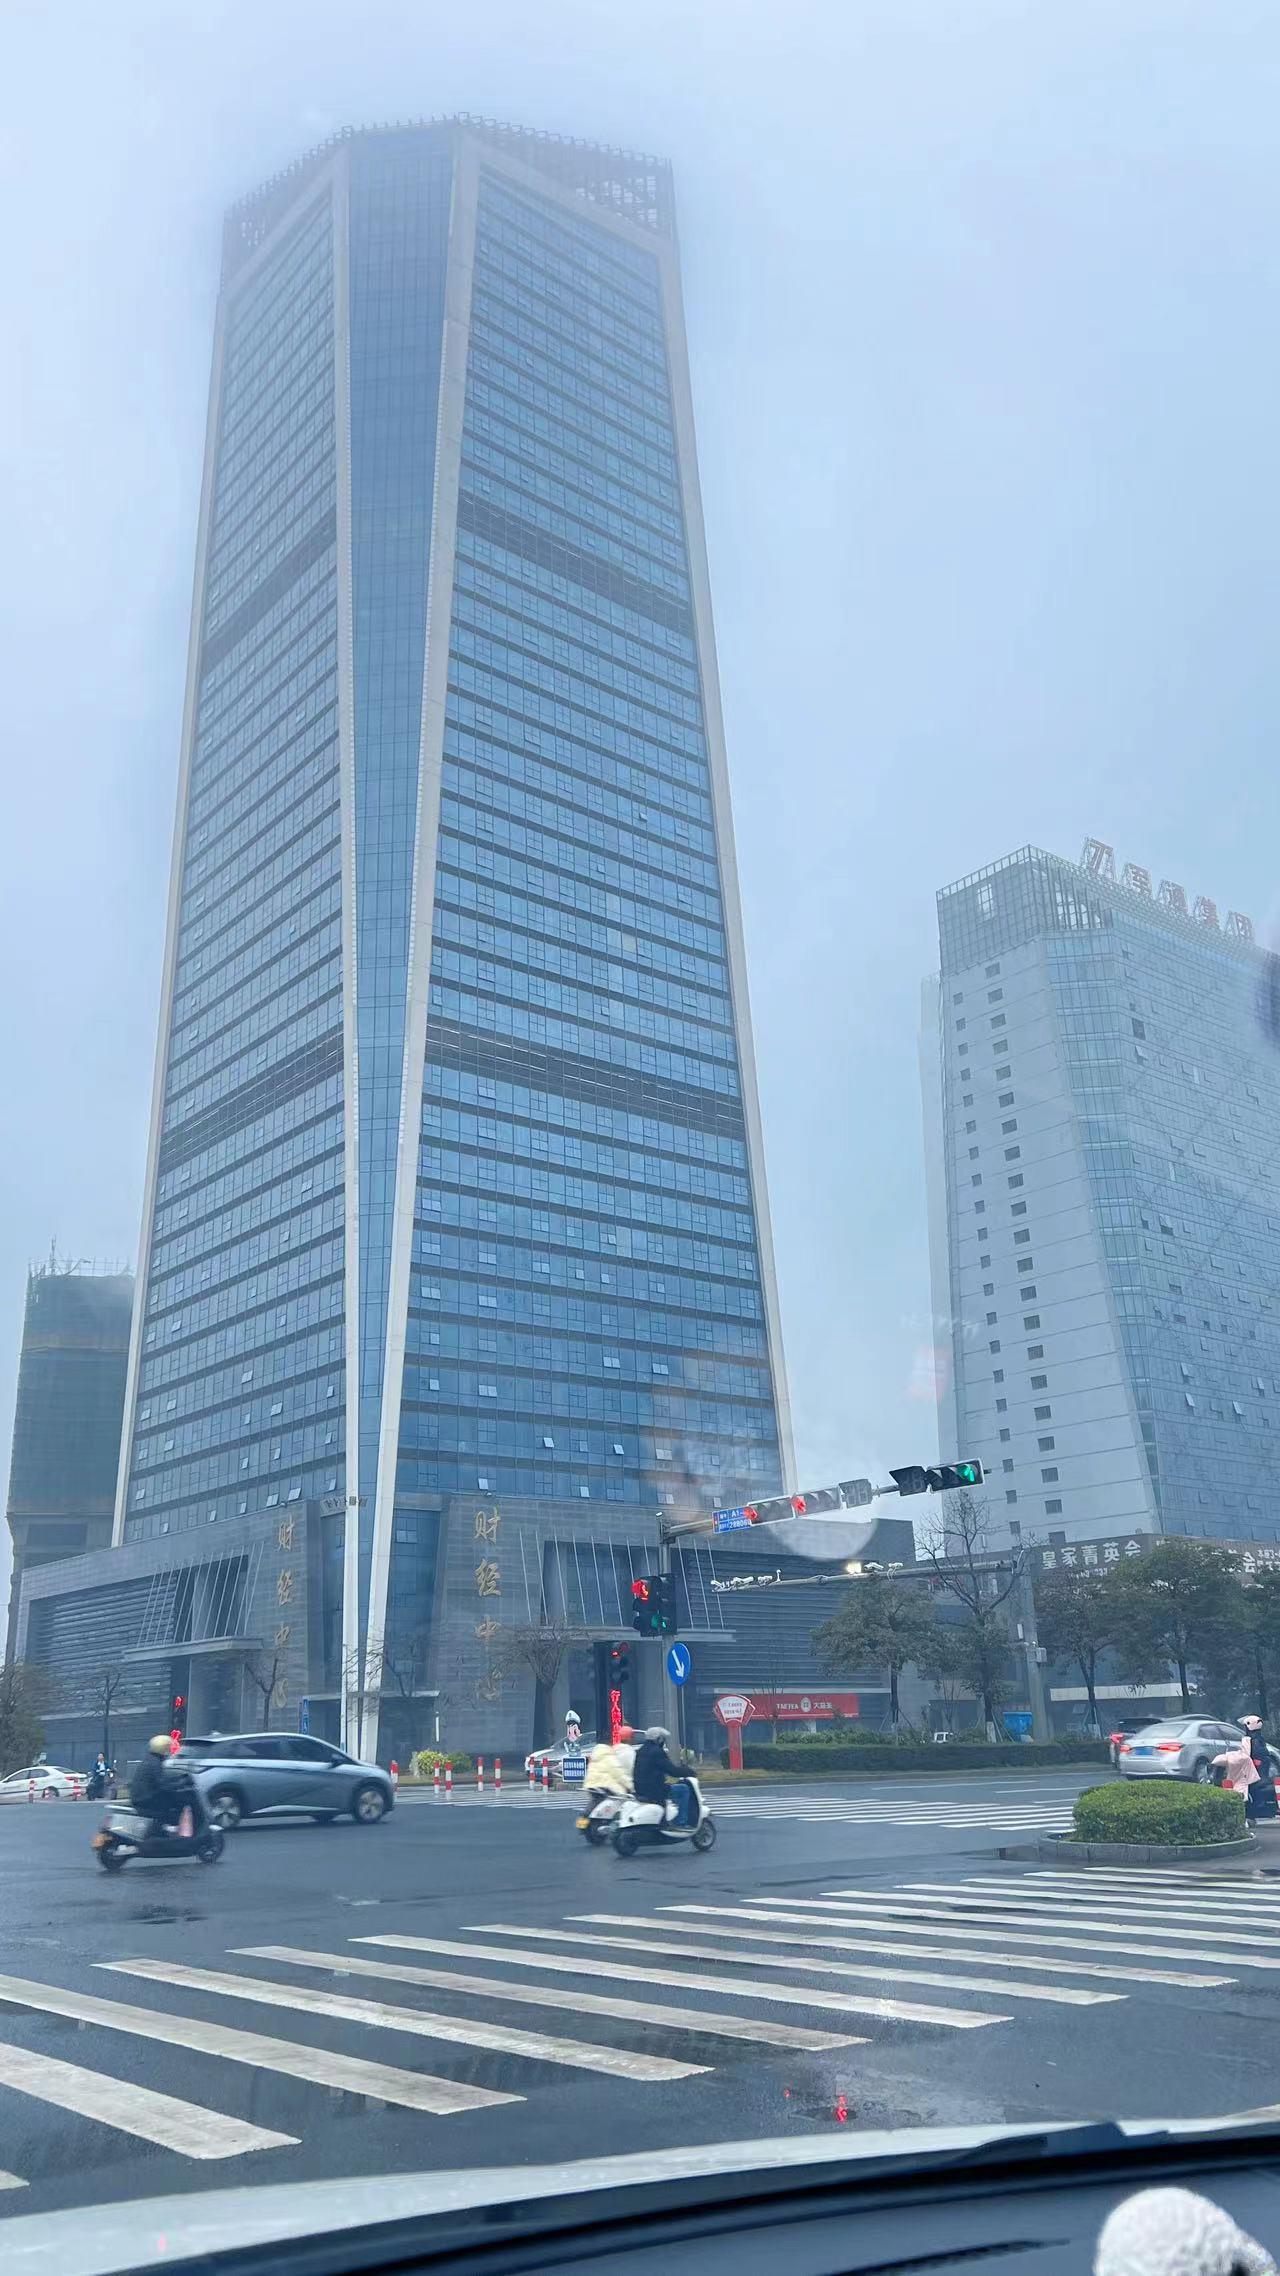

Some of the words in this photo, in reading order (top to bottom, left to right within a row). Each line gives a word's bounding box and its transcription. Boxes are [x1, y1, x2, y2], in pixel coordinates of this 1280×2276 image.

[1042, 1539, 1141, 1570] 皇家菁英会
